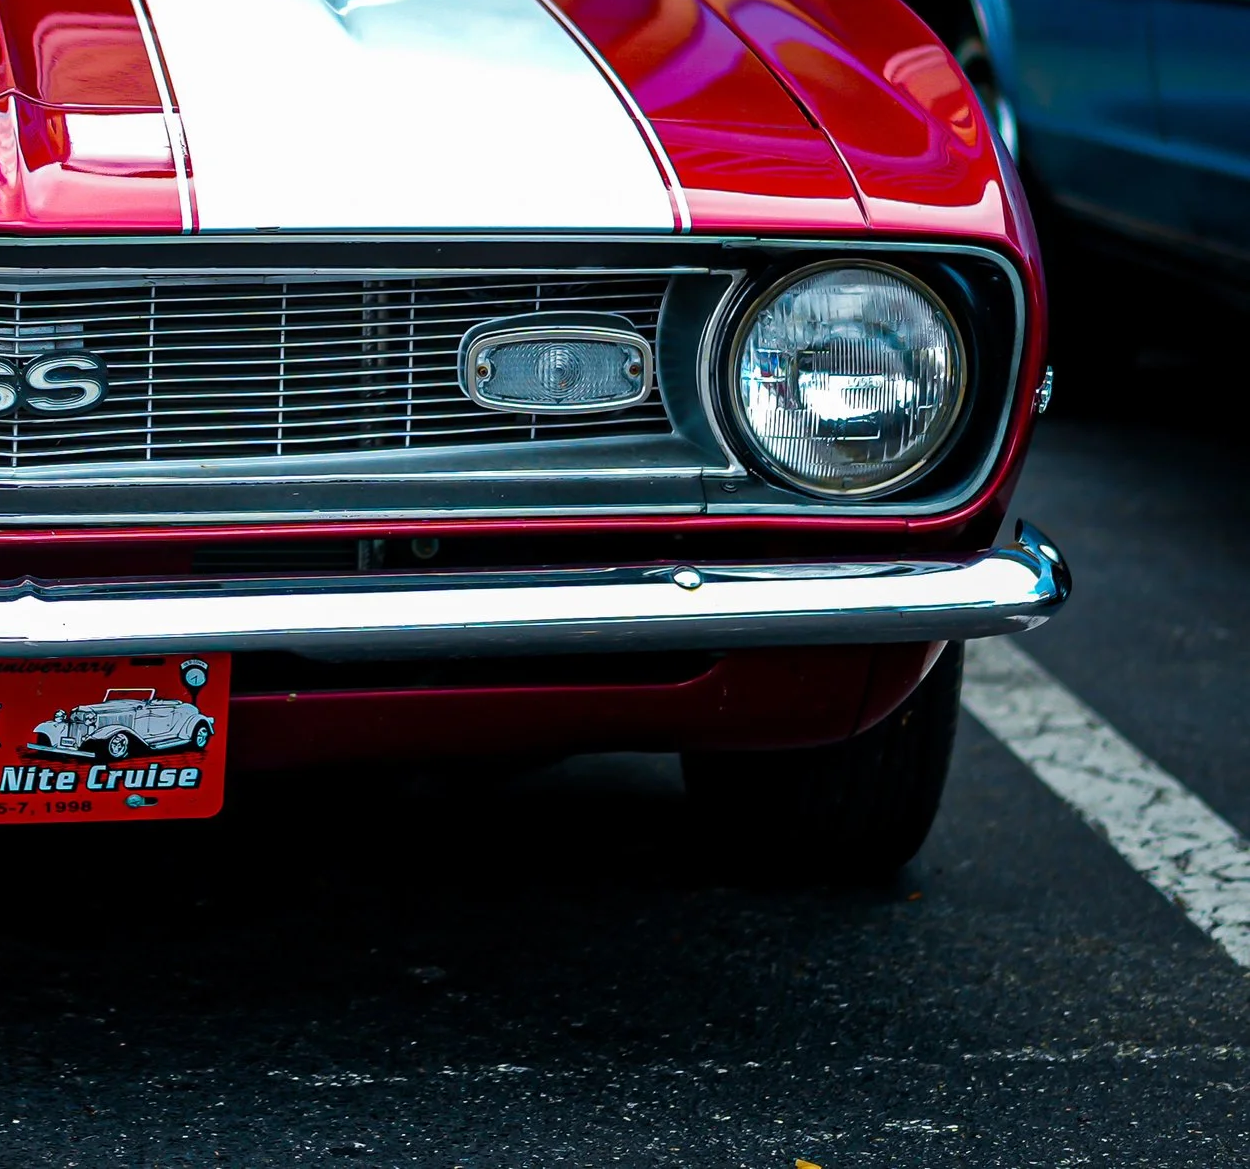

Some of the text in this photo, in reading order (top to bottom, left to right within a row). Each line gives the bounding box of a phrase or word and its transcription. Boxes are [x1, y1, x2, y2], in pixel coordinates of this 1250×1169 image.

[0, 765, 79, 792] Nite
[86, 764, 200, 791] Cruise
[44, 800, 93, 814] 1998
